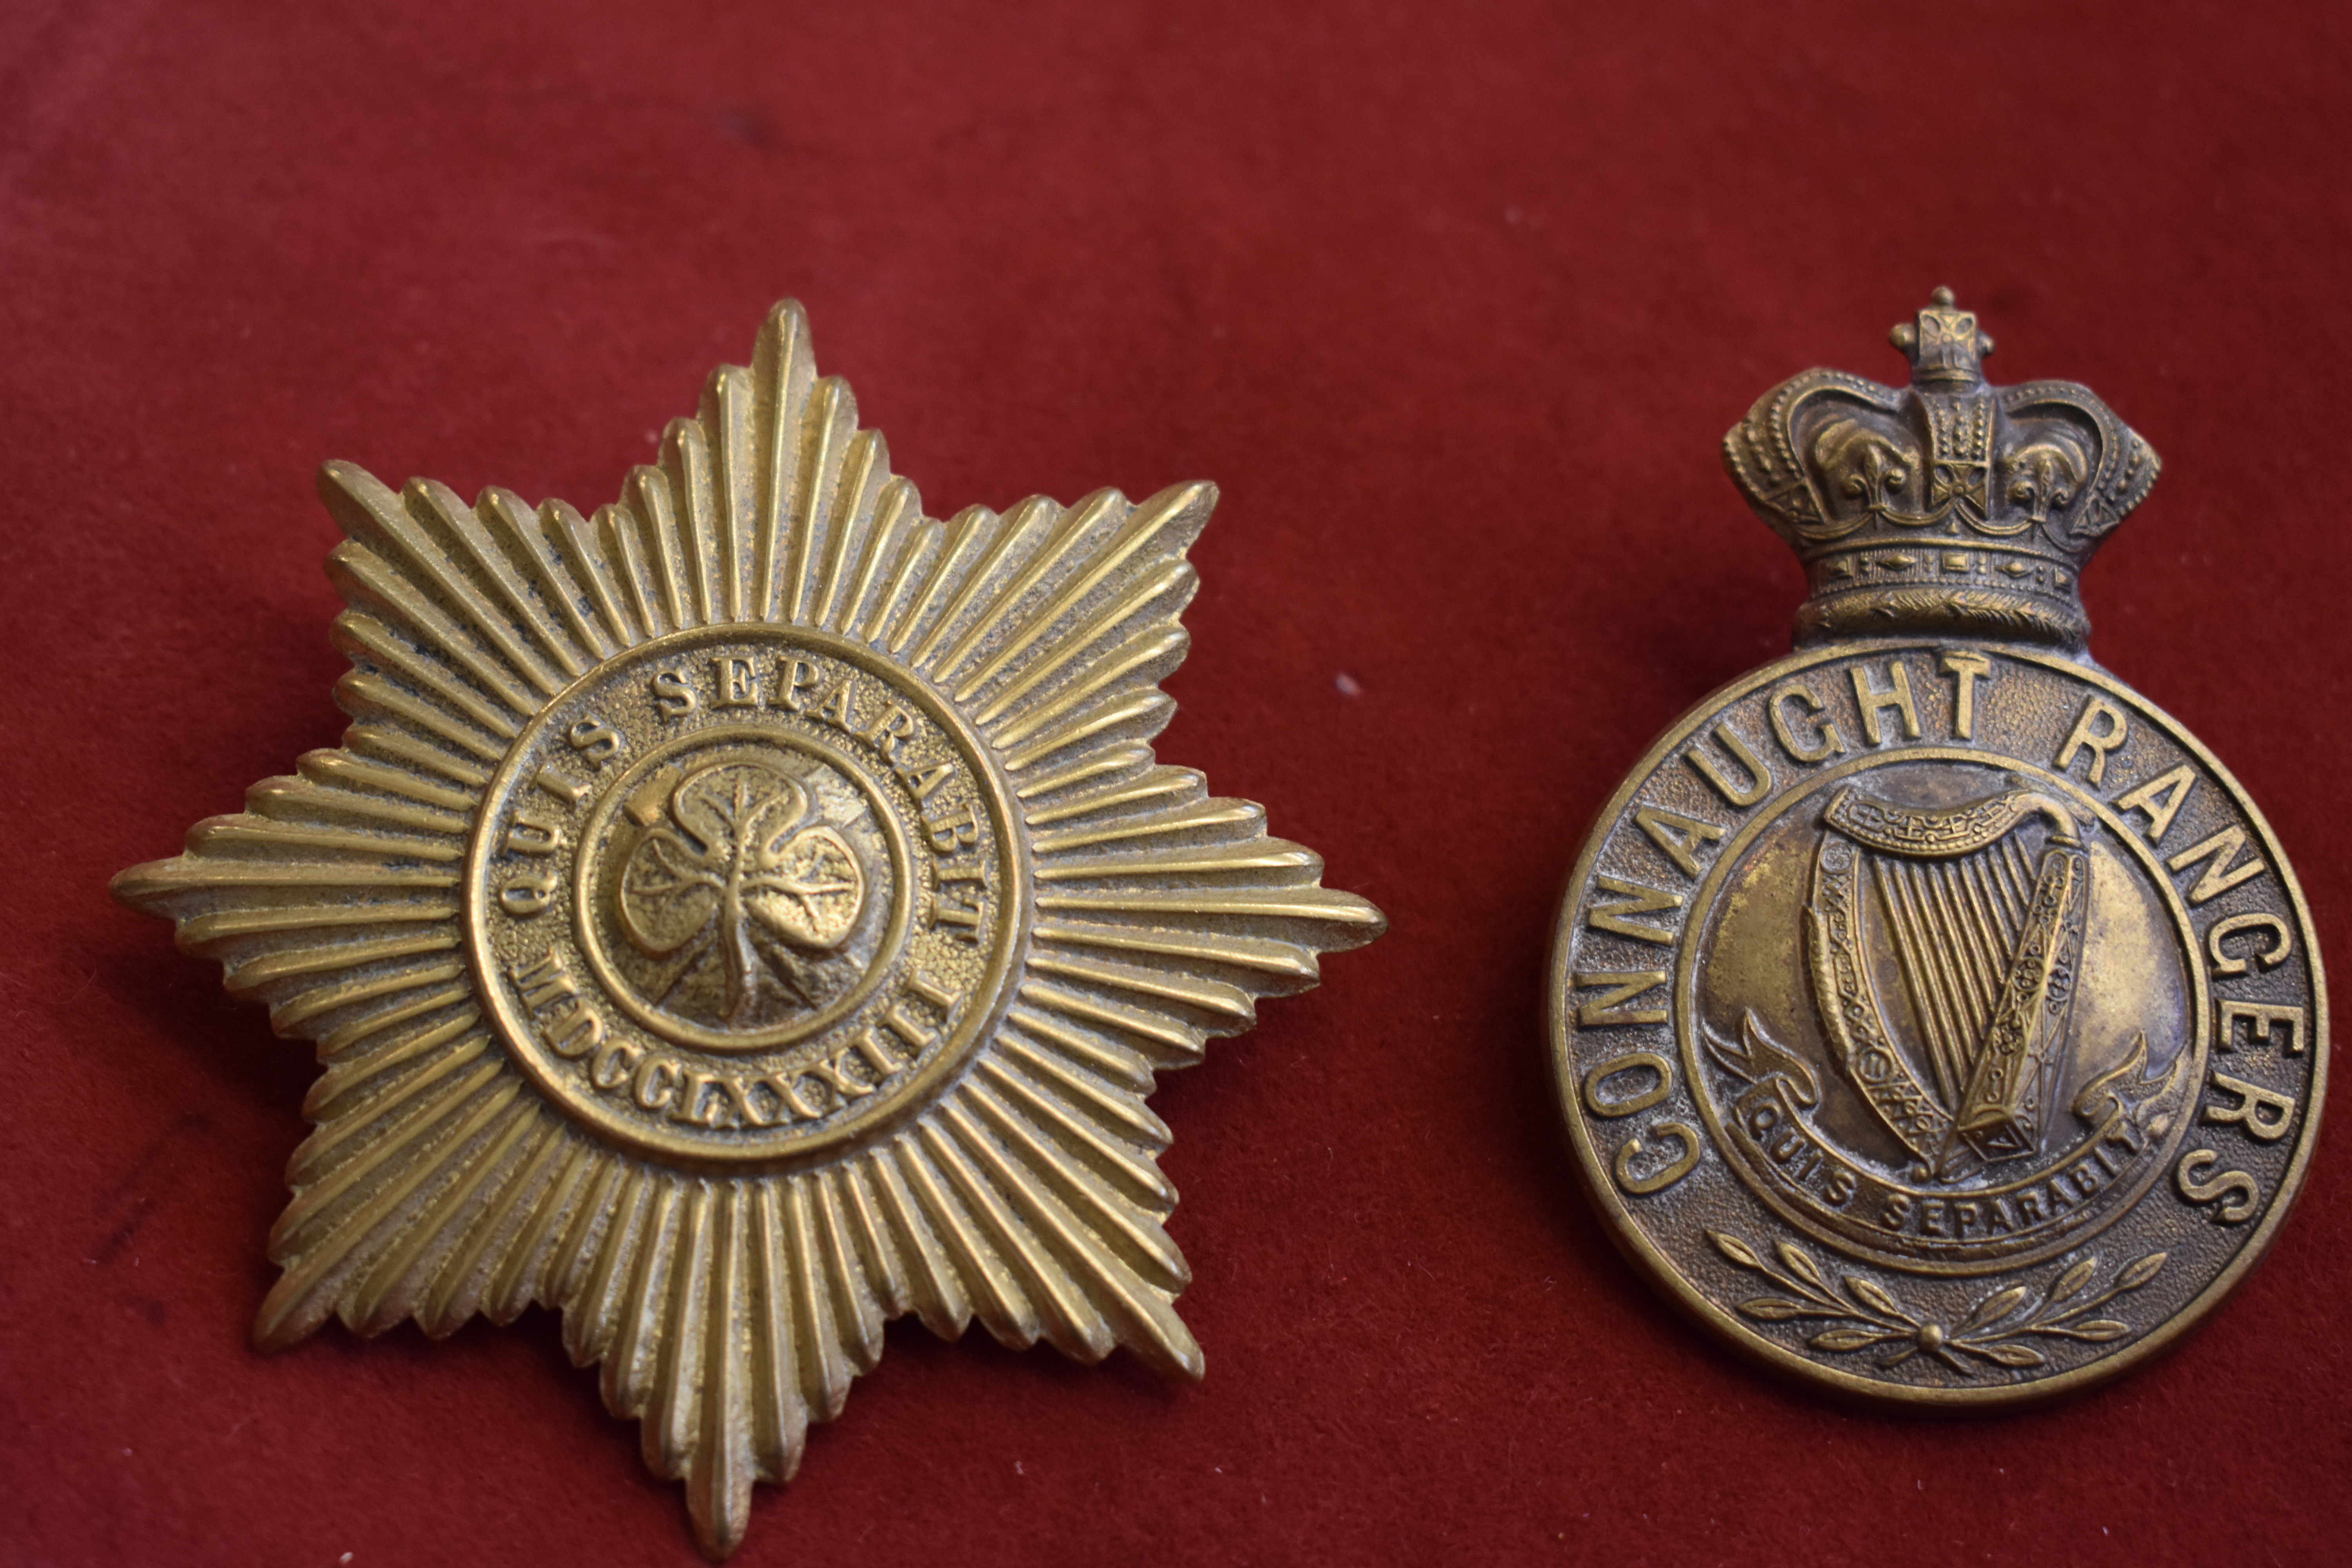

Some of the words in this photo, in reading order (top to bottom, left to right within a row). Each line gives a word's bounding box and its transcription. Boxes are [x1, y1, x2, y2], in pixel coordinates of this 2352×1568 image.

[499, 713, 622, 916] QUIS
[652, 653, 989, 946] SEPARABIT
[508, 946, 967, 1130] MDCCLXXXIII
[1577, 650, 1991, 1196] CONNAUGHT
[2054, 695, 2305, 1227] RANGERS
[1748, 1101, 1857, 1207] QUIS
[1878, 1120, 2143, 1238] SEPARABIT
